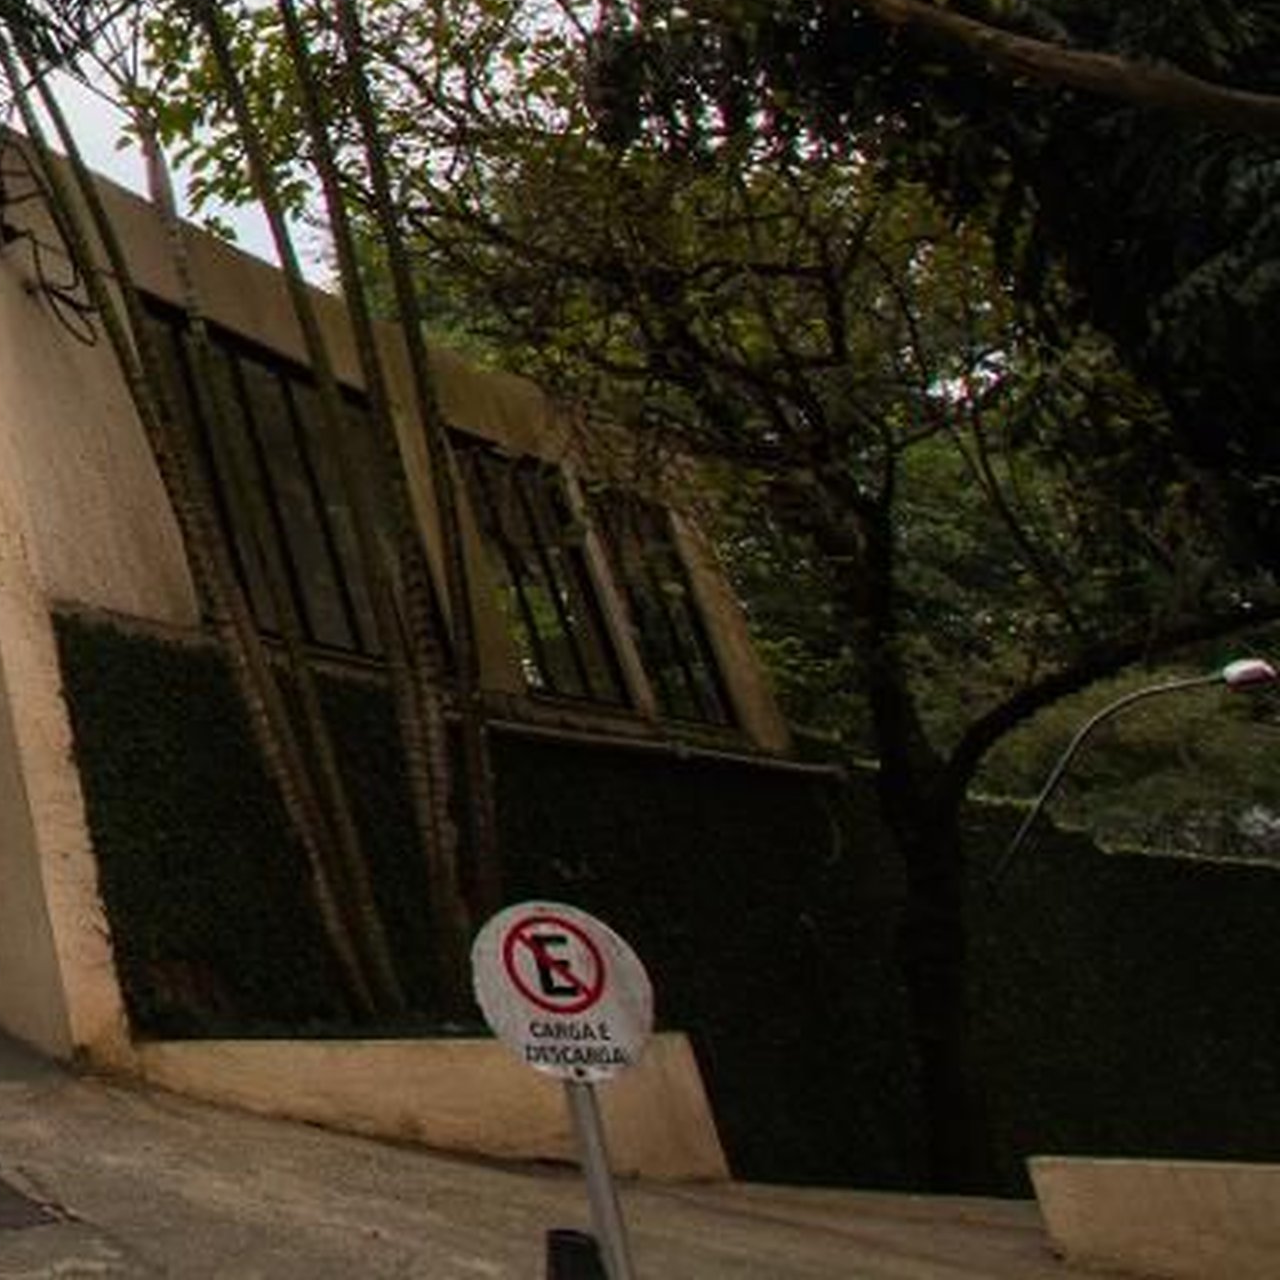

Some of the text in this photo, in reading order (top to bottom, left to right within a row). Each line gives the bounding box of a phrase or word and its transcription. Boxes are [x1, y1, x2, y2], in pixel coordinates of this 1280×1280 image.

[529, 1021, 612, 1041] CARGA E
[525, 1044, 627, 1066] DESCARGA
